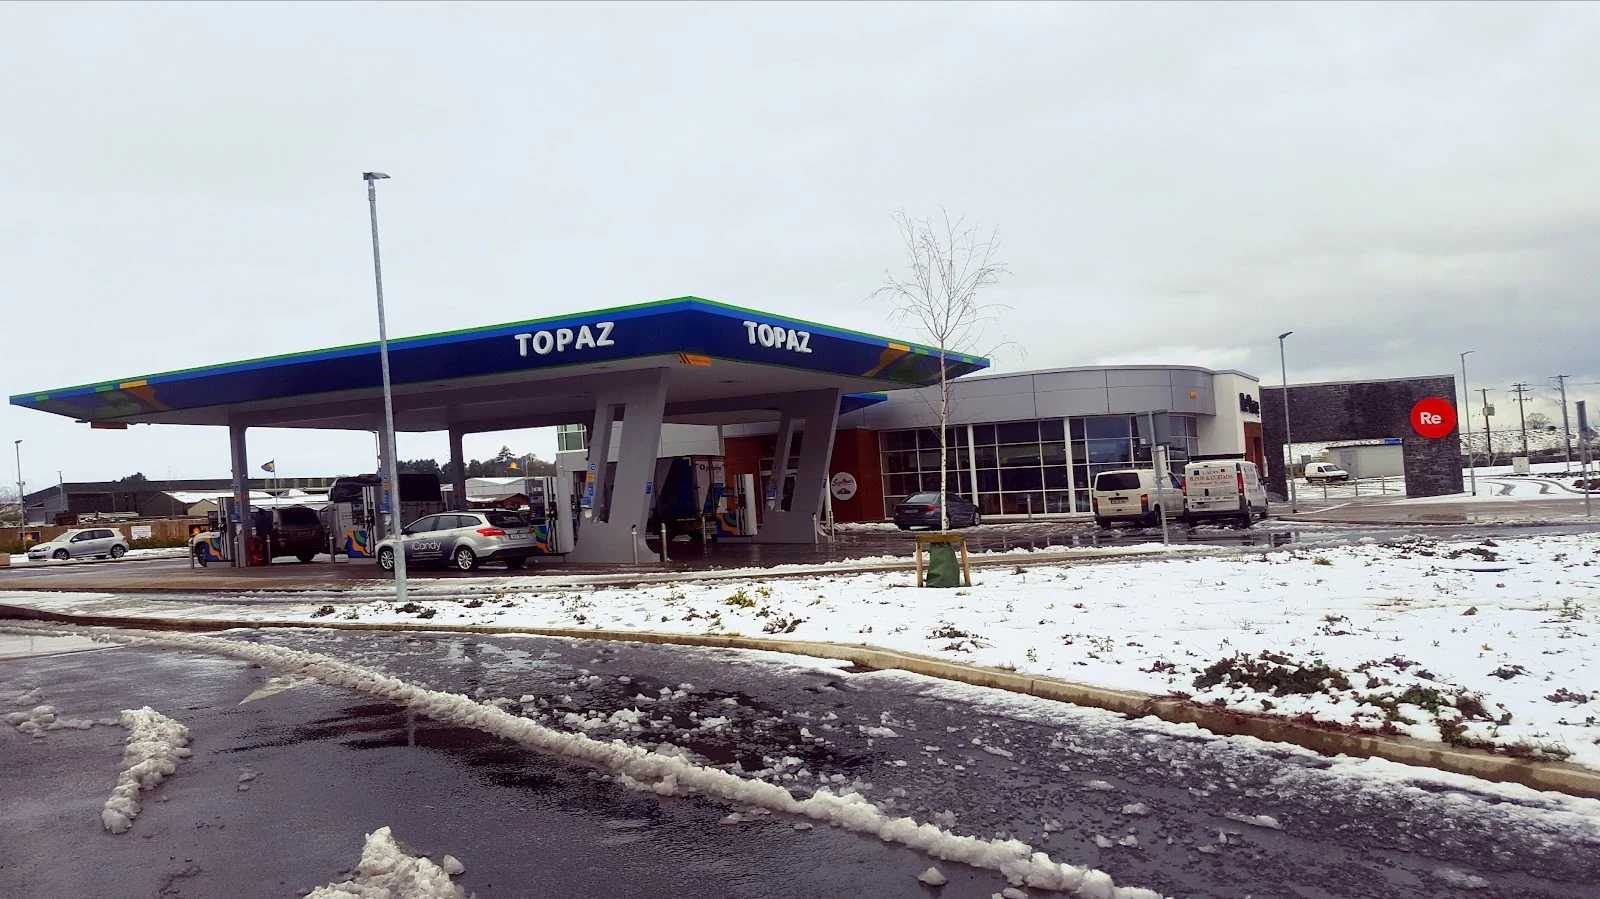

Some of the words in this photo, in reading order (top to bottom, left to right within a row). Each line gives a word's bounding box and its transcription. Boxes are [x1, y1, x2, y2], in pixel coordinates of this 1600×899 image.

[514, 321, 615, 357] TOPAZ
[743, 320, 813, 353] TOPAZ
[411, 540, 442, 551] iCandy
